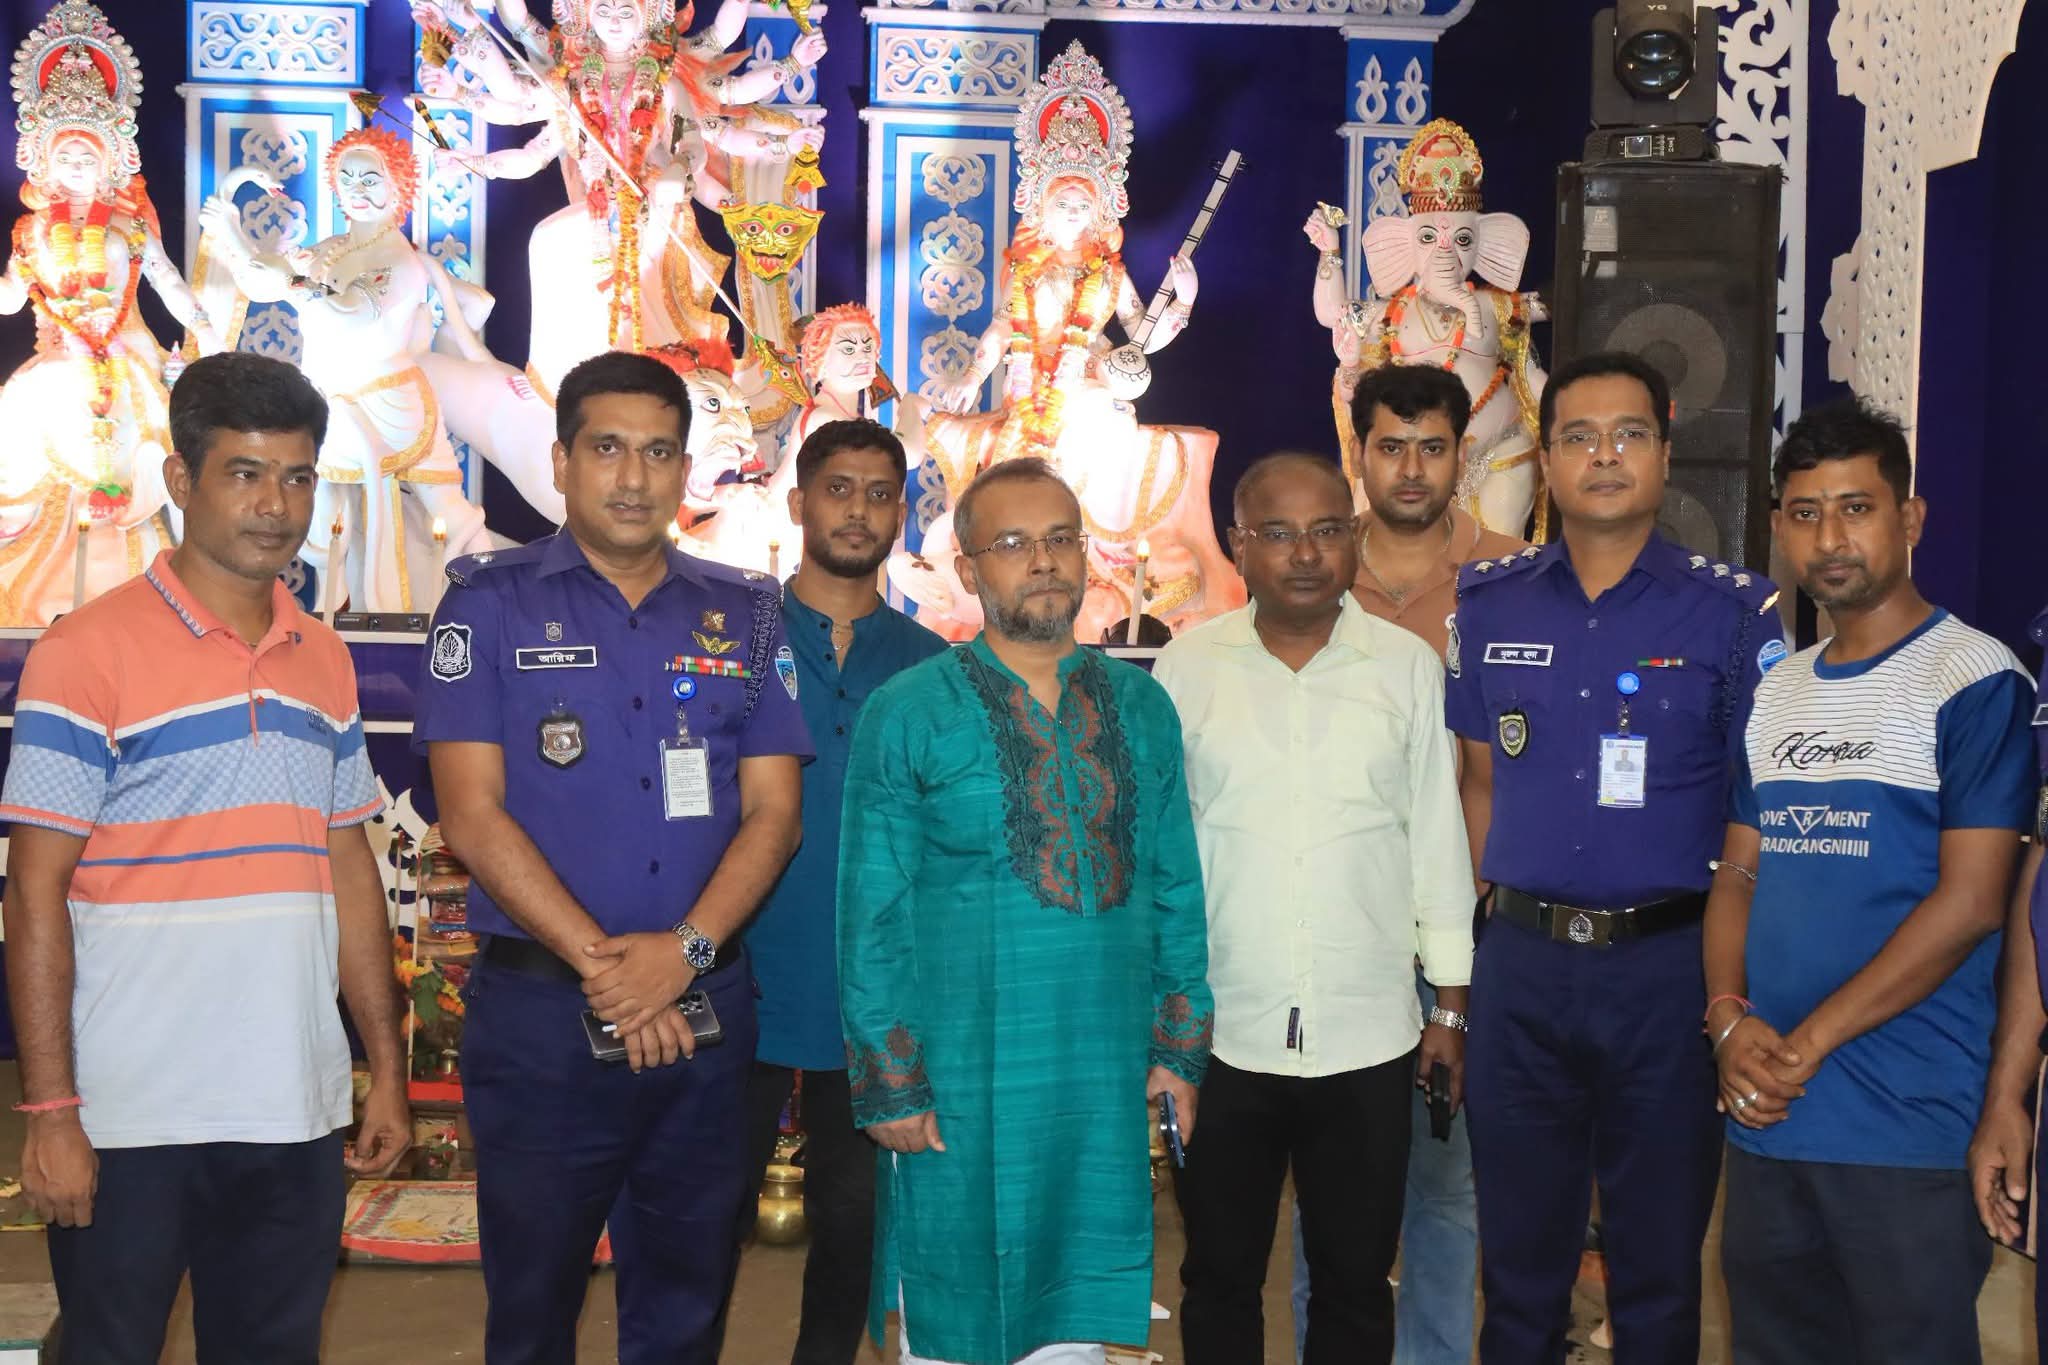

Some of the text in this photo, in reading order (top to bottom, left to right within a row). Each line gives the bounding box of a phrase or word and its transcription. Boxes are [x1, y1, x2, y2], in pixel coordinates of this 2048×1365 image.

[537, 651, 577, 664] আরিফ
[1771, 730, 1877, 770] Korea
[1824, 810, 1871, 828] MENT
